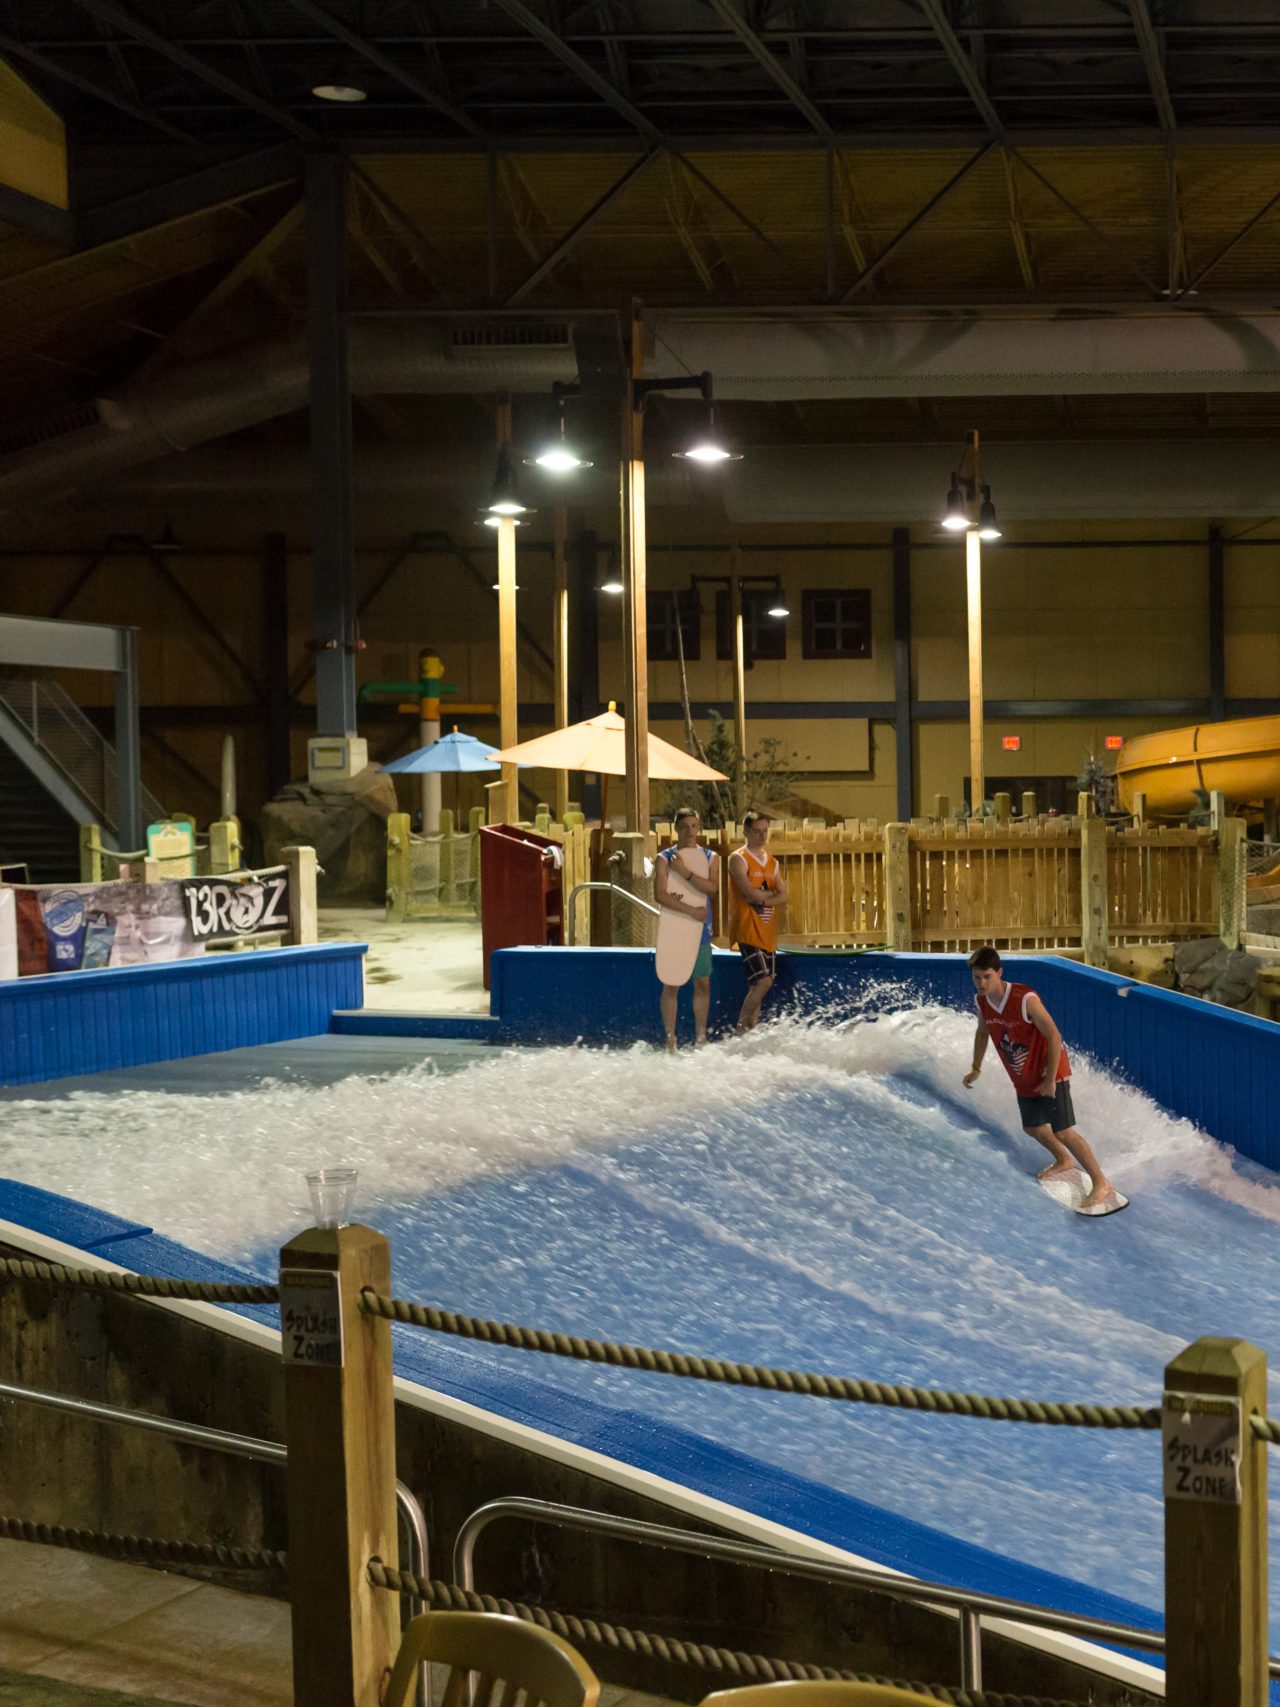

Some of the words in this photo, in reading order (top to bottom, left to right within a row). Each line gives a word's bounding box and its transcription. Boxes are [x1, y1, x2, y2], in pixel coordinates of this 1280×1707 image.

[185, 878, 289, 936] 13ROZ
[284, 1308, 338, 1336] SPLASH
[292, 1334, 338, 1360] ZONE
[1167, 1435, 1236, 1469] SPLASH
[1175, 1465, 1228, 1496] ZONE
